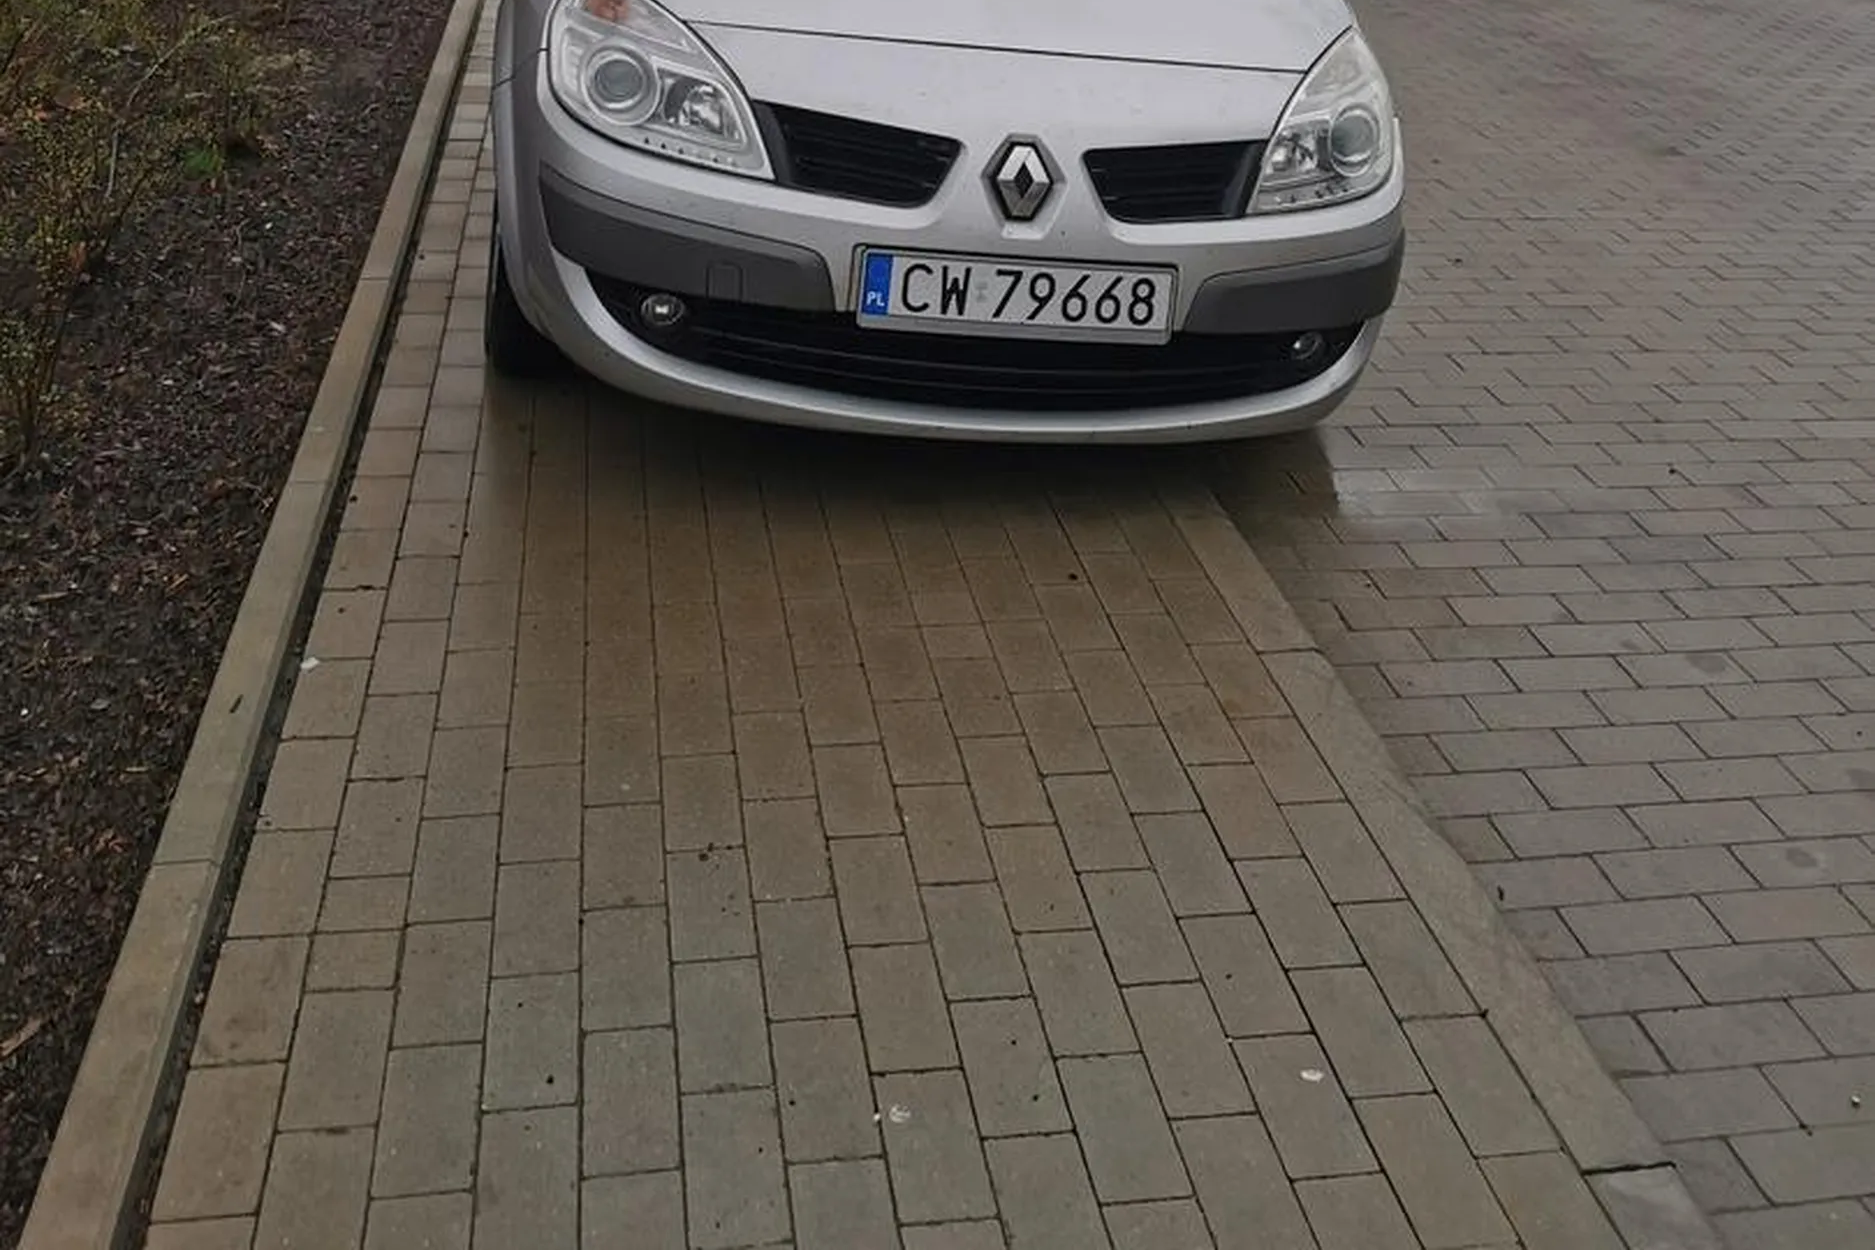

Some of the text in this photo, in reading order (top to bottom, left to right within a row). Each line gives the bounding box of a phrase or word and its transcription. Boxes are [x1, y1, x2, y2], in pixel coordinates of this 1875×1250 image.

[866, 290, 886, 307] PL
[902, 263, 1156, 326] CW 79668
